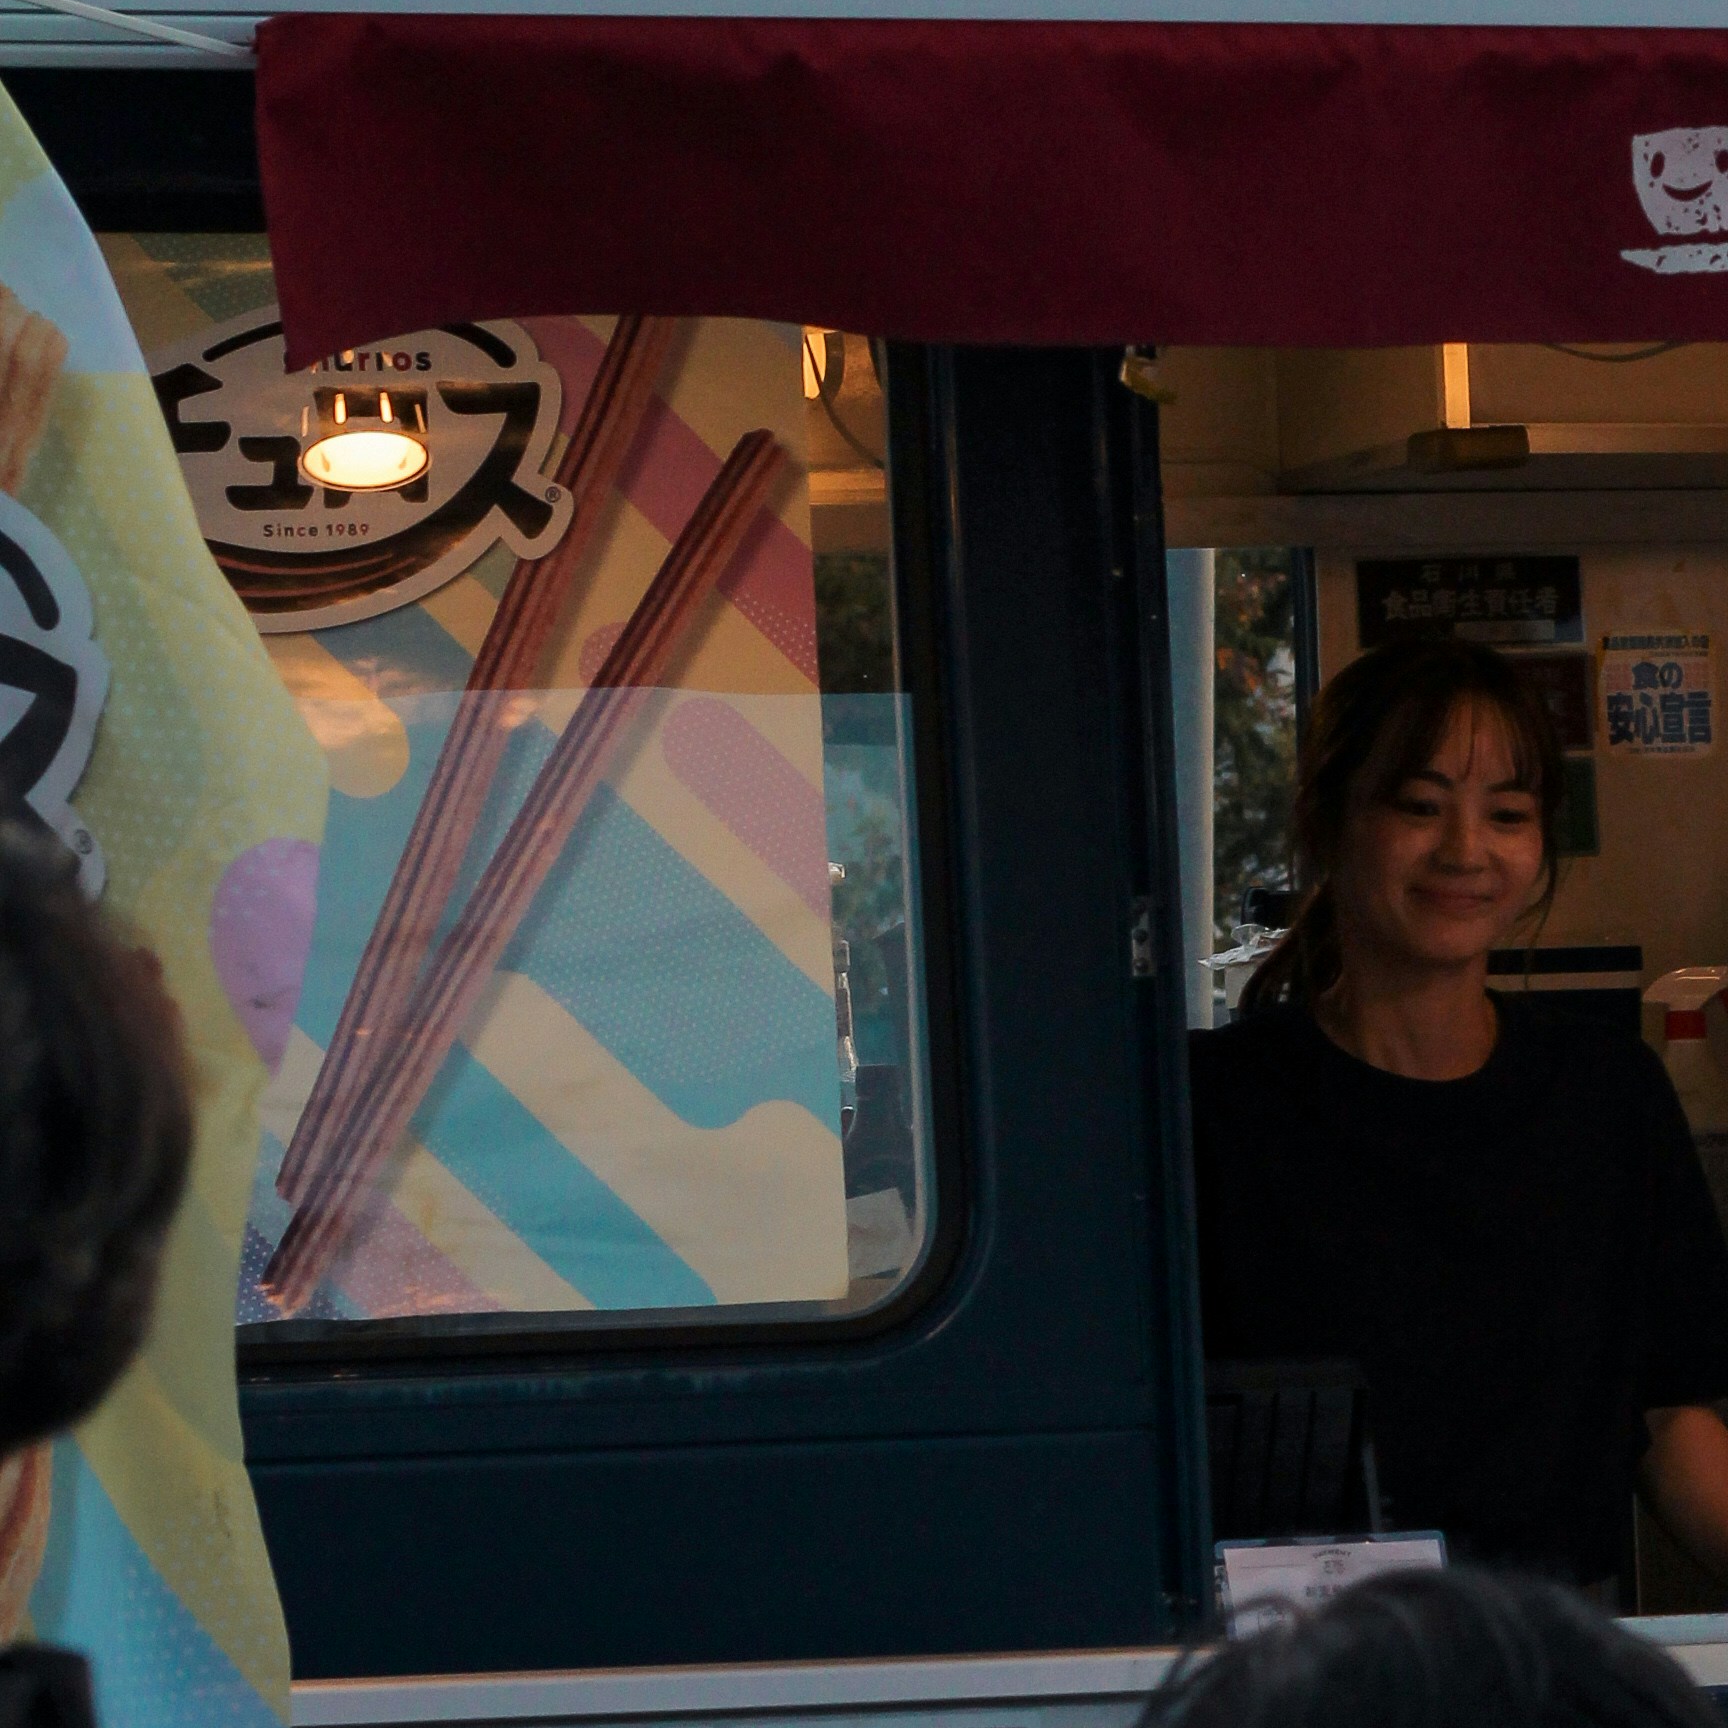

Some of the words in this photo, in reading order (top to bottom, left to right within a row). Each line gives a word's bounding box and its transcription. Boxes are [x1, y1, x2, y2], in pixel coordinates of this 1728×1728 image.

[262, 522, 320, 539] Since
[325, 522, 371, 539] 1989
[1632, 662, 1683, 690] 食の
[1606, 692, 1712, 745] 安心宣言
